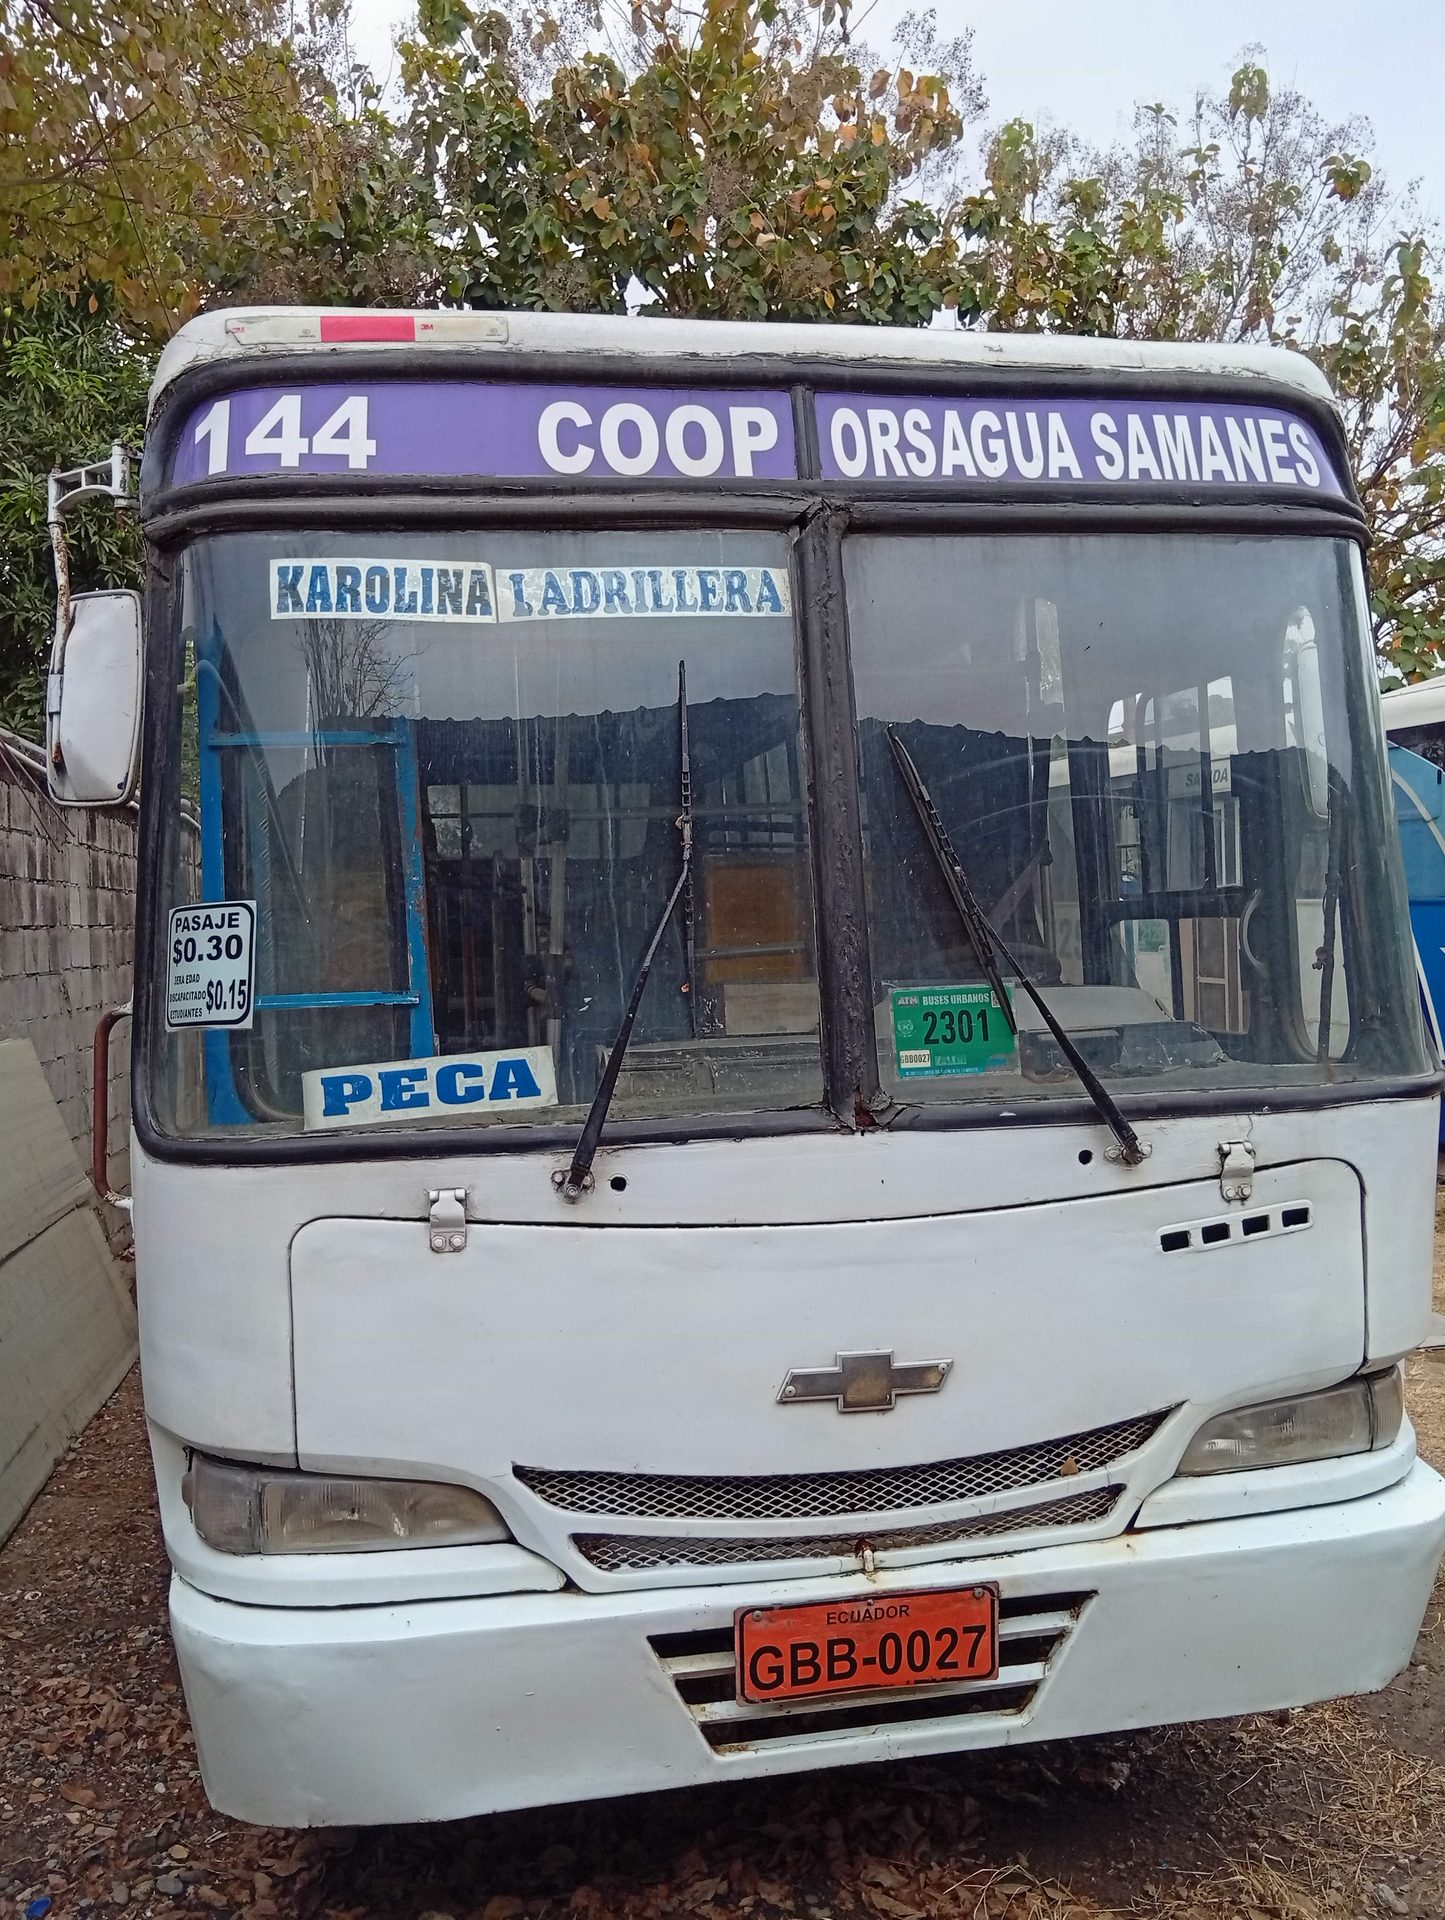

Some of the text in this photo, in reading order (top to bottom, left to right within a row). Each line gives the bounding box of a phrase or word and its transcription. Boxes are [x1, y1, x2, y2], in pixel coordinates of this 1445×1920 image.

[194, 394, 779, 477] 144 COOP
[830, 407, 1321, 487] ORSAGUA SAMANES
[276, 565, 785, 617] KAROLINA LADRILLERA
[175, 912, 240, 933] PASAJE
[172, 934, 243, 967] $0.30
[186, 973, 201, 984] EDAD
[206, 979, 247, 1014] $0.15
[922, 993, 989, 1006] BUSES URBANOS
[922, 1008, 990, 1045] 2301
[320, 1058, 542, 1117] PECA
[826, 1604, 910, 1625] ECUADOR
[750, 1624, 987, 1691] GBB-0027
